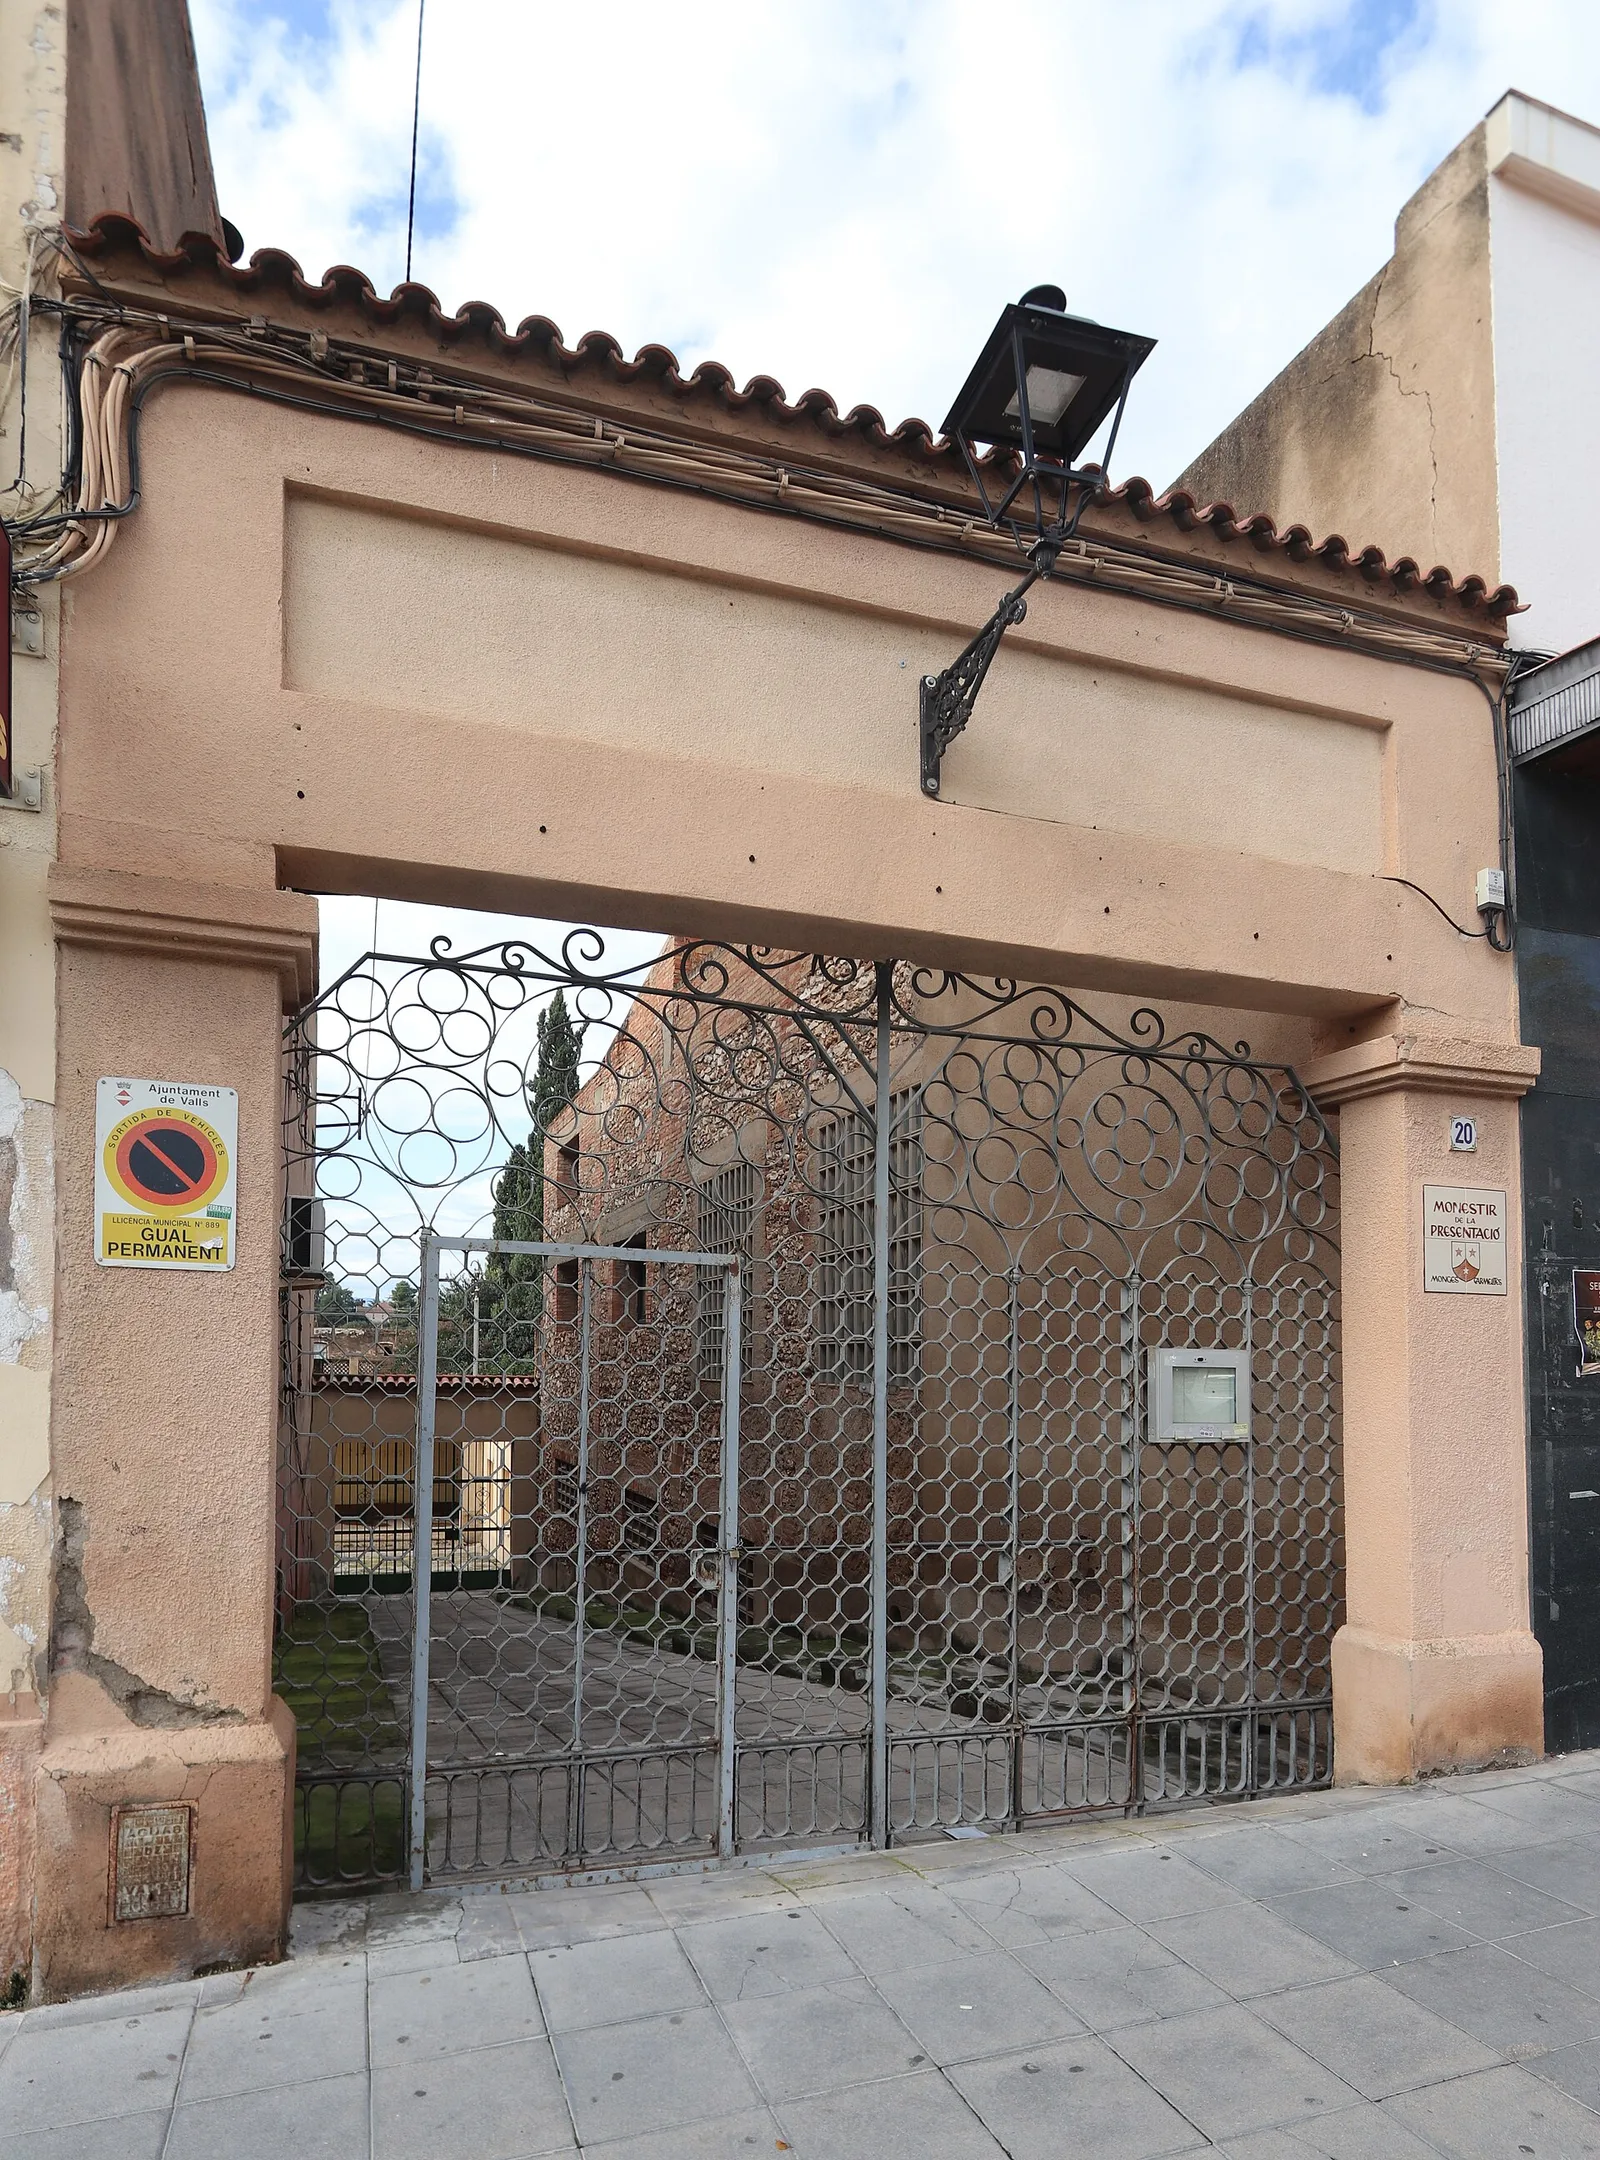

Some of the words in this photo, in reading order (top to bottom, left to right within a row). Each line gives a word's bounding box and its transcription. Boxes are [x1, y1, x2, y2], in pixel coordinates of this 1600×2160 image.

[148, 1084, 220, 1098] Ajuntament
[160, 1096, 175, 1104] de
[180, 1097, 209, 1107] Valls
[157, 1109, 172, 1117] DE
[108, 1113, 147, 1149] SORTIDA
[183, 1113, 226, 1156] VEHICLES
[1455, 1122, 1472, 1144] 20
[1433, 1201, 1497, 1216] MONESTIR
[153, 1219, 191, 1227] MUNICIPAL
[141, 1227, 192, 1243] GUAL
[1430, 1225, 1500, 1240] PRESENTACIÓ
[108, 1242, 223, 1260] PERMANENT
